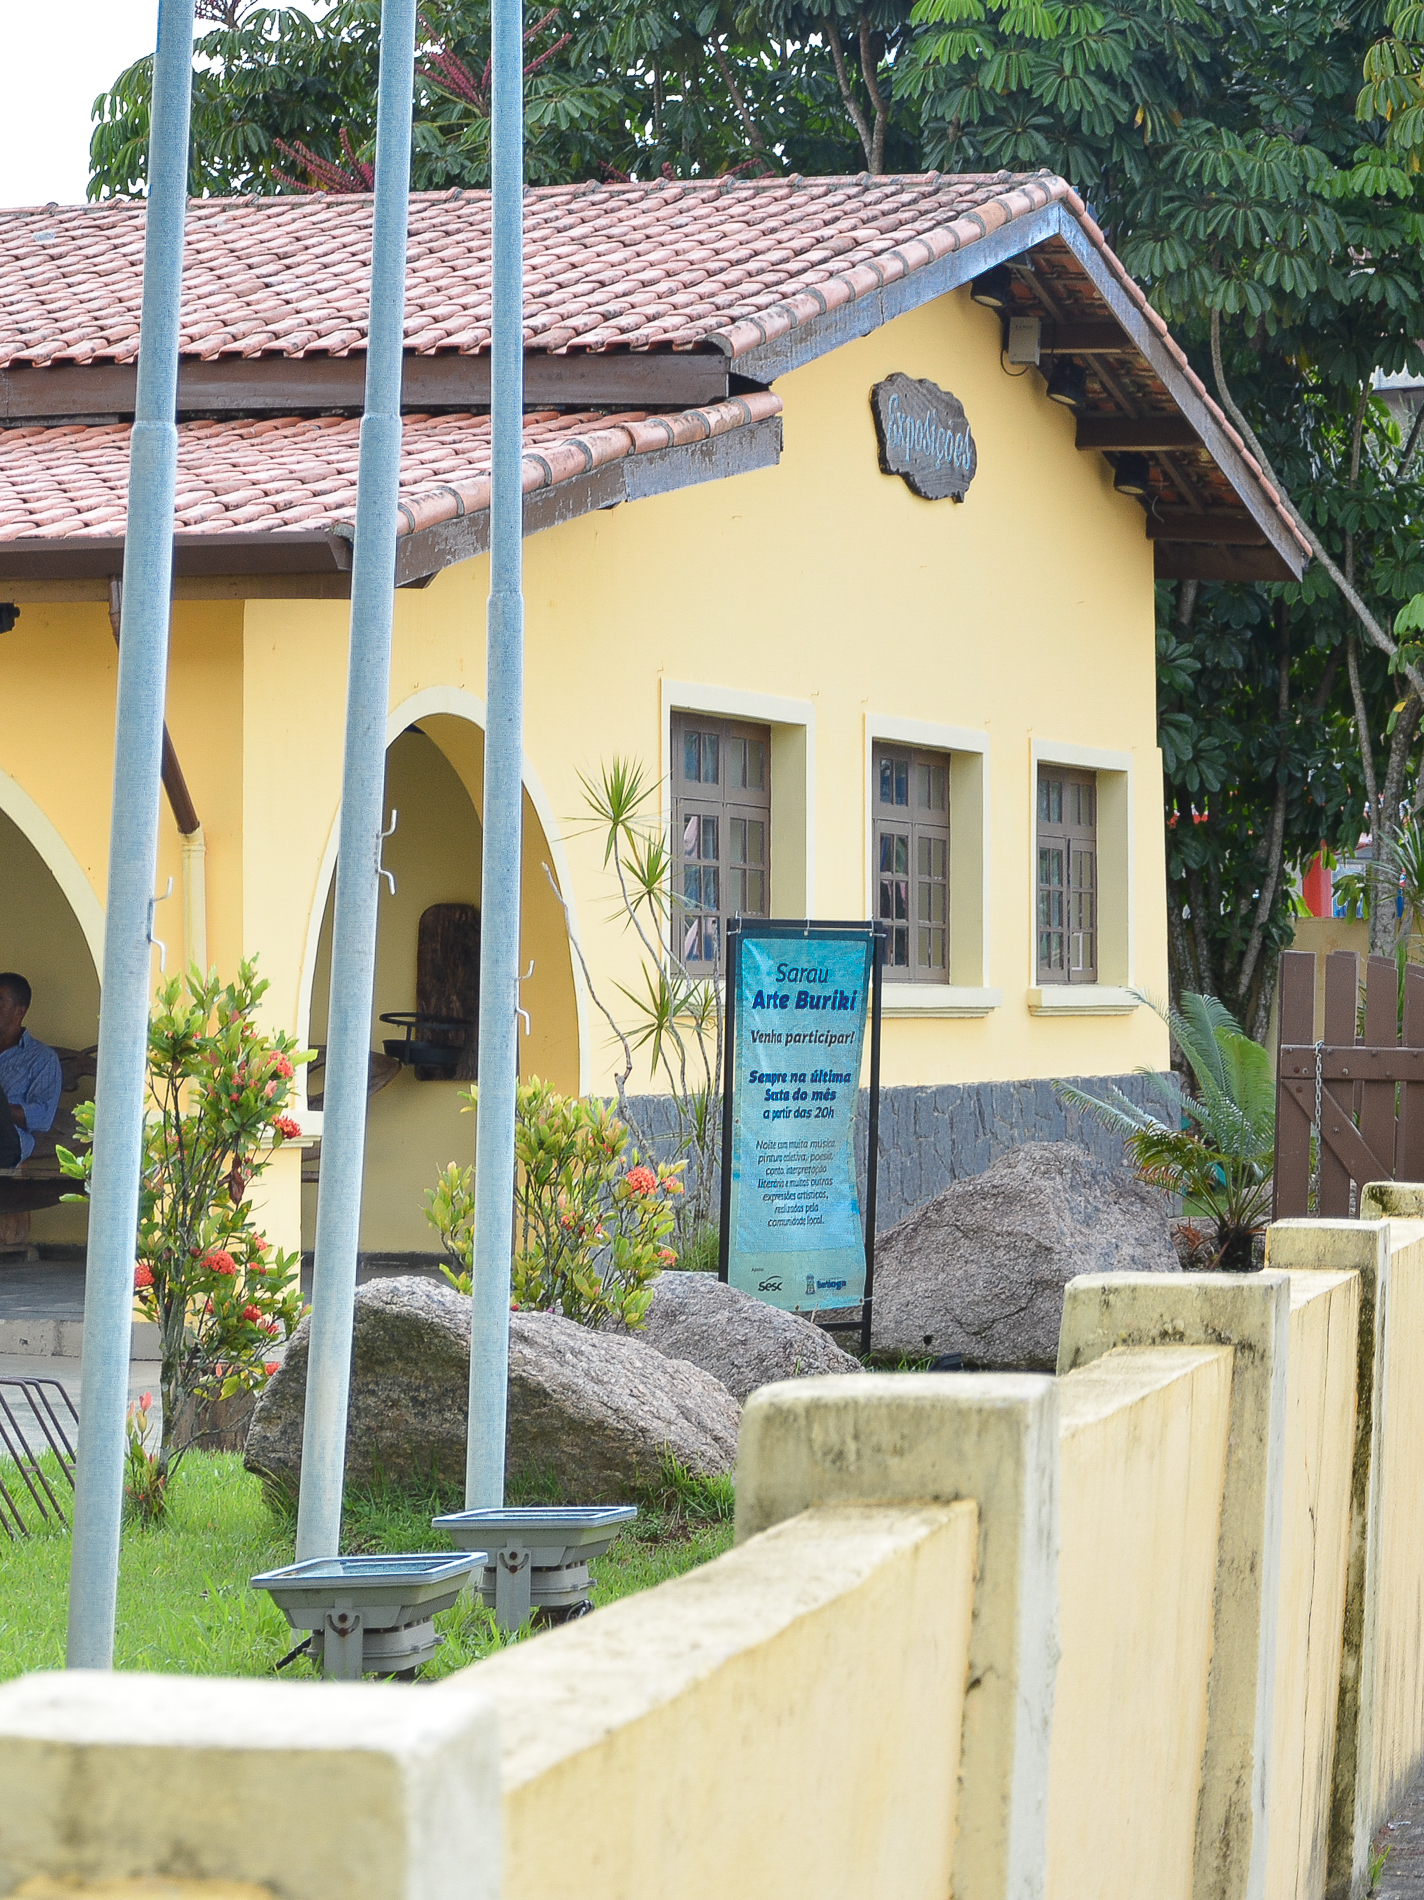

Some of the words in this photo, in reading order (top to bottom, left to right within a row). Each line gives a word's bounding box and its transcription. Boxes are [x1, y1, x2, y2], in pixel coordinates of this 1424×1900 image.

[887, 393, 972, 471] Exposições
[775, 962, 829, 984] Sarau
[752, 990, 789, 1010] Arte
[795, 990, 858, 1011] Buriki
[751, 1029, 783, 1044] Venha
[785, 1030, 855, 1047] participar!
[748, 1069, 787, 1086] Sempre
[790, 1072, 807, 1083] na
[810, 1069, 852, 1083] última
[792, 1087, 808, 1101] do
[811, 1087, 837, 1101] mês
[763, 1109, 770, 1119] a
[772, 1106, 792, 1122] partir
[793, 1106, 812, 1119] das
[814, 1106, 834, 1119] 20h
[755, 1140, 777, 1150] Noite
[788, 1140, 809, 1149] muita
[810, 1177, 834, 1187] outras
[805, 1203, 819, 1214] pela
